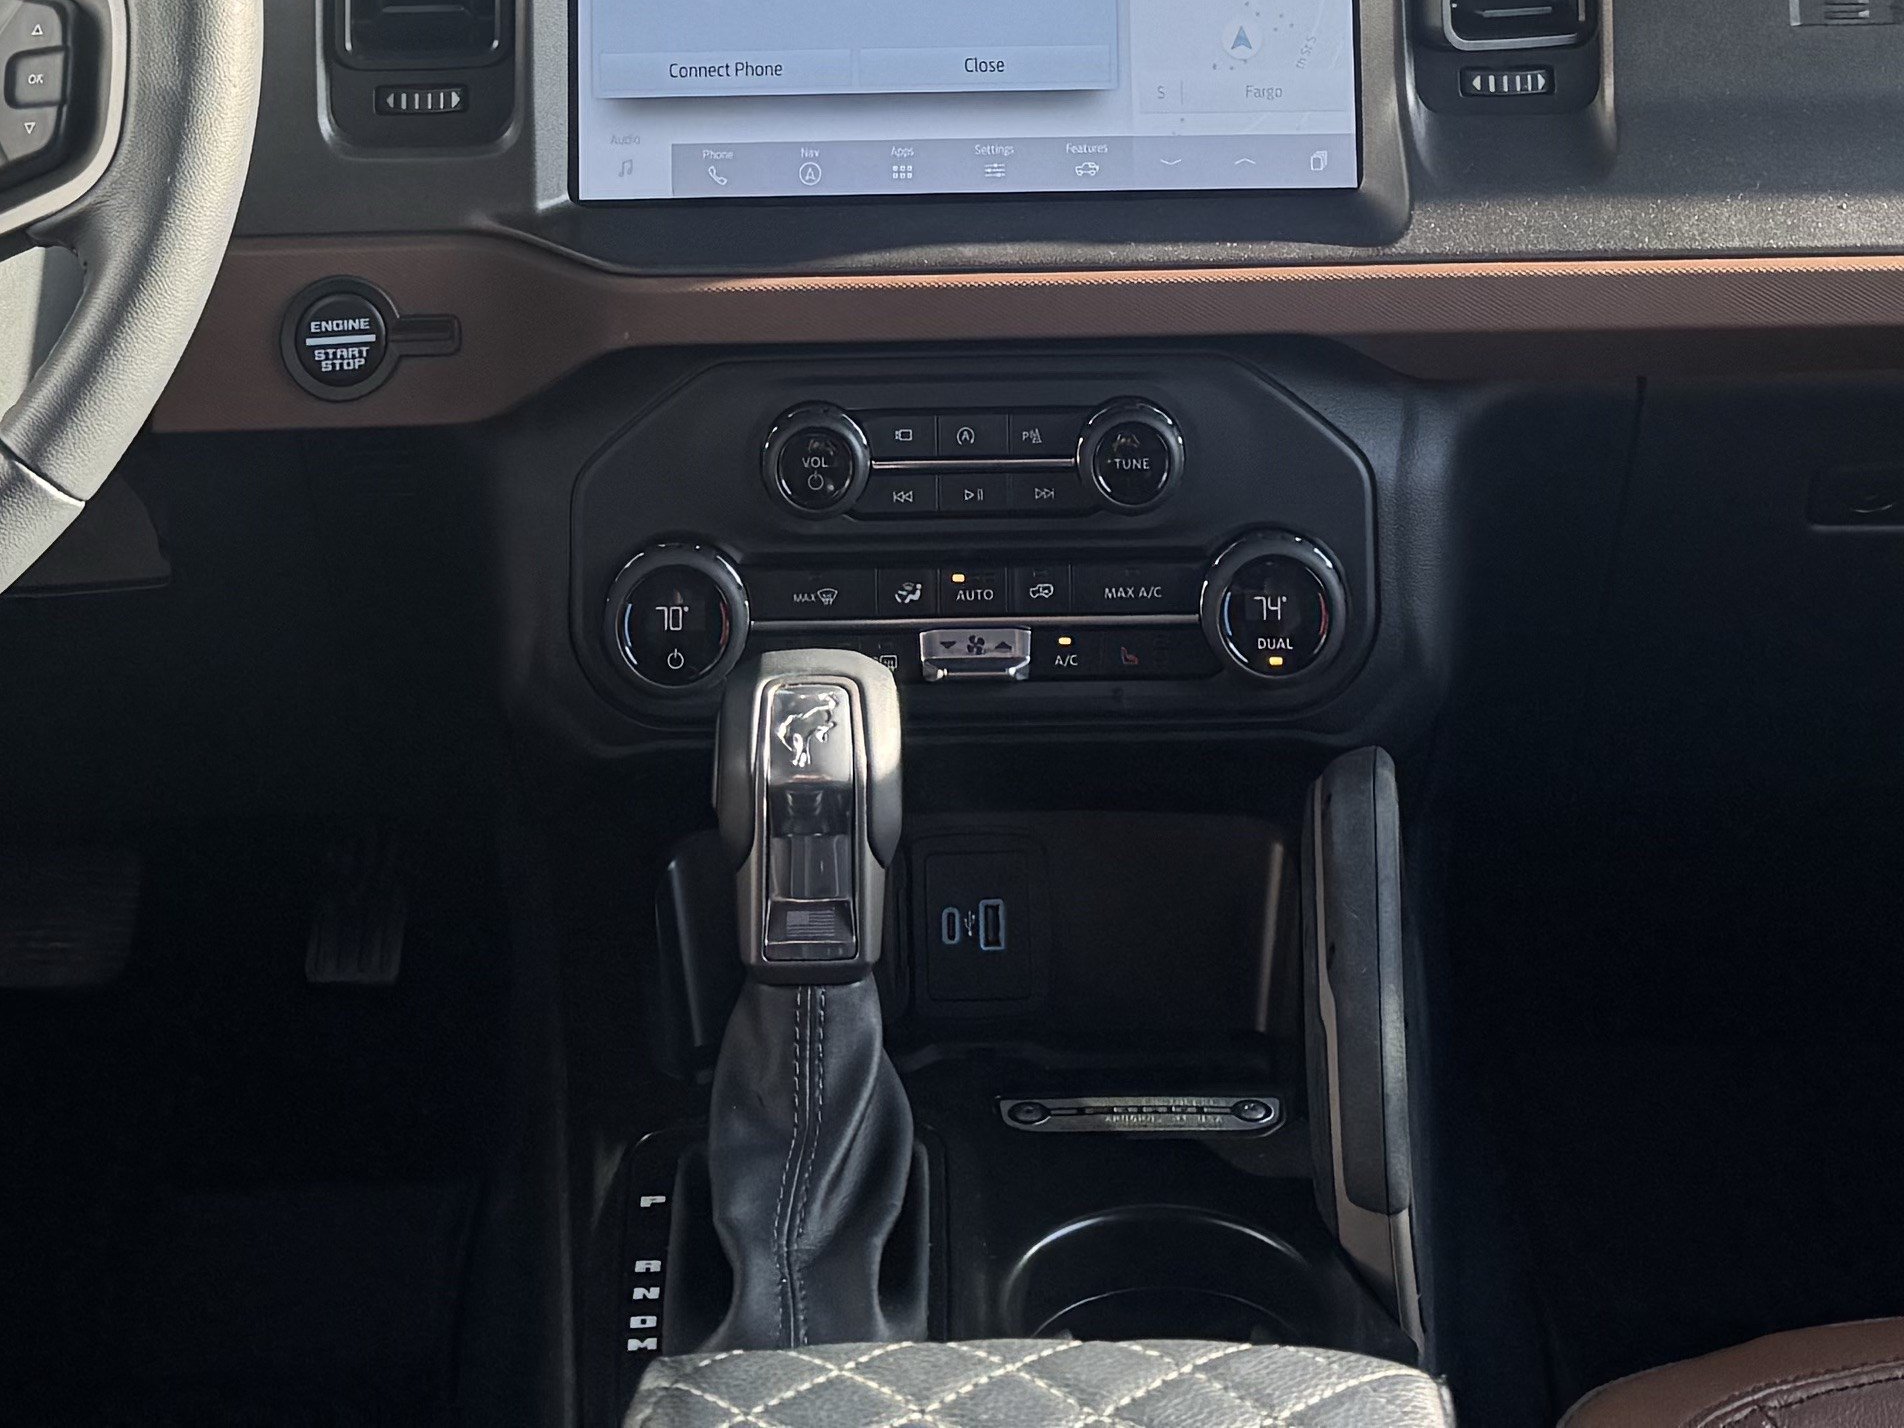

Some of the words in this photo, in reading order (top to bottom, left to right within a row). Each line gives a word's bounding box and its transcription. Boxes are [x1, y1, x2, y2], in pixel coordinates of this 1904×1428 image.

[668, 62, 730, 79] Connect
[735, 61, 784, 78] Phone
[964, 57, 1005, 74] Close
[28, 74, 44, 85] OK
[1156, 85, 1166, 100] S
[1245, 84, 1283, 101] Fargo
[609, 134, 641, 145] Audio
[702, 149, 734, 160] Phone
[800, 147, 820, 158] Nav
[890, 145, 915, 159] Apps
[974, 144, 1015, 157] Settings
[1066, 143, 1109, 155] Features
[310, 318, 370, 333] ENGINE
[314, 346, 370, 361] START
[321, 358, 366, 372] STOP
[802, 456, 829, 469] VOL
[1113, 457, 1150, 470] TUNE
[793, 593, 817, 604] MAX
[956, 589, 994, 601] AUTO
[1104, 587, 1135, 599] MAX
[1139, 585, 1162, 599] A/C
[1257, 637, 1294, 650] DUAL
[1054, 653, 1078, 667] A/C
[632, 1286, 660, 1300] N
[627, 1337, 658, 1352] M
